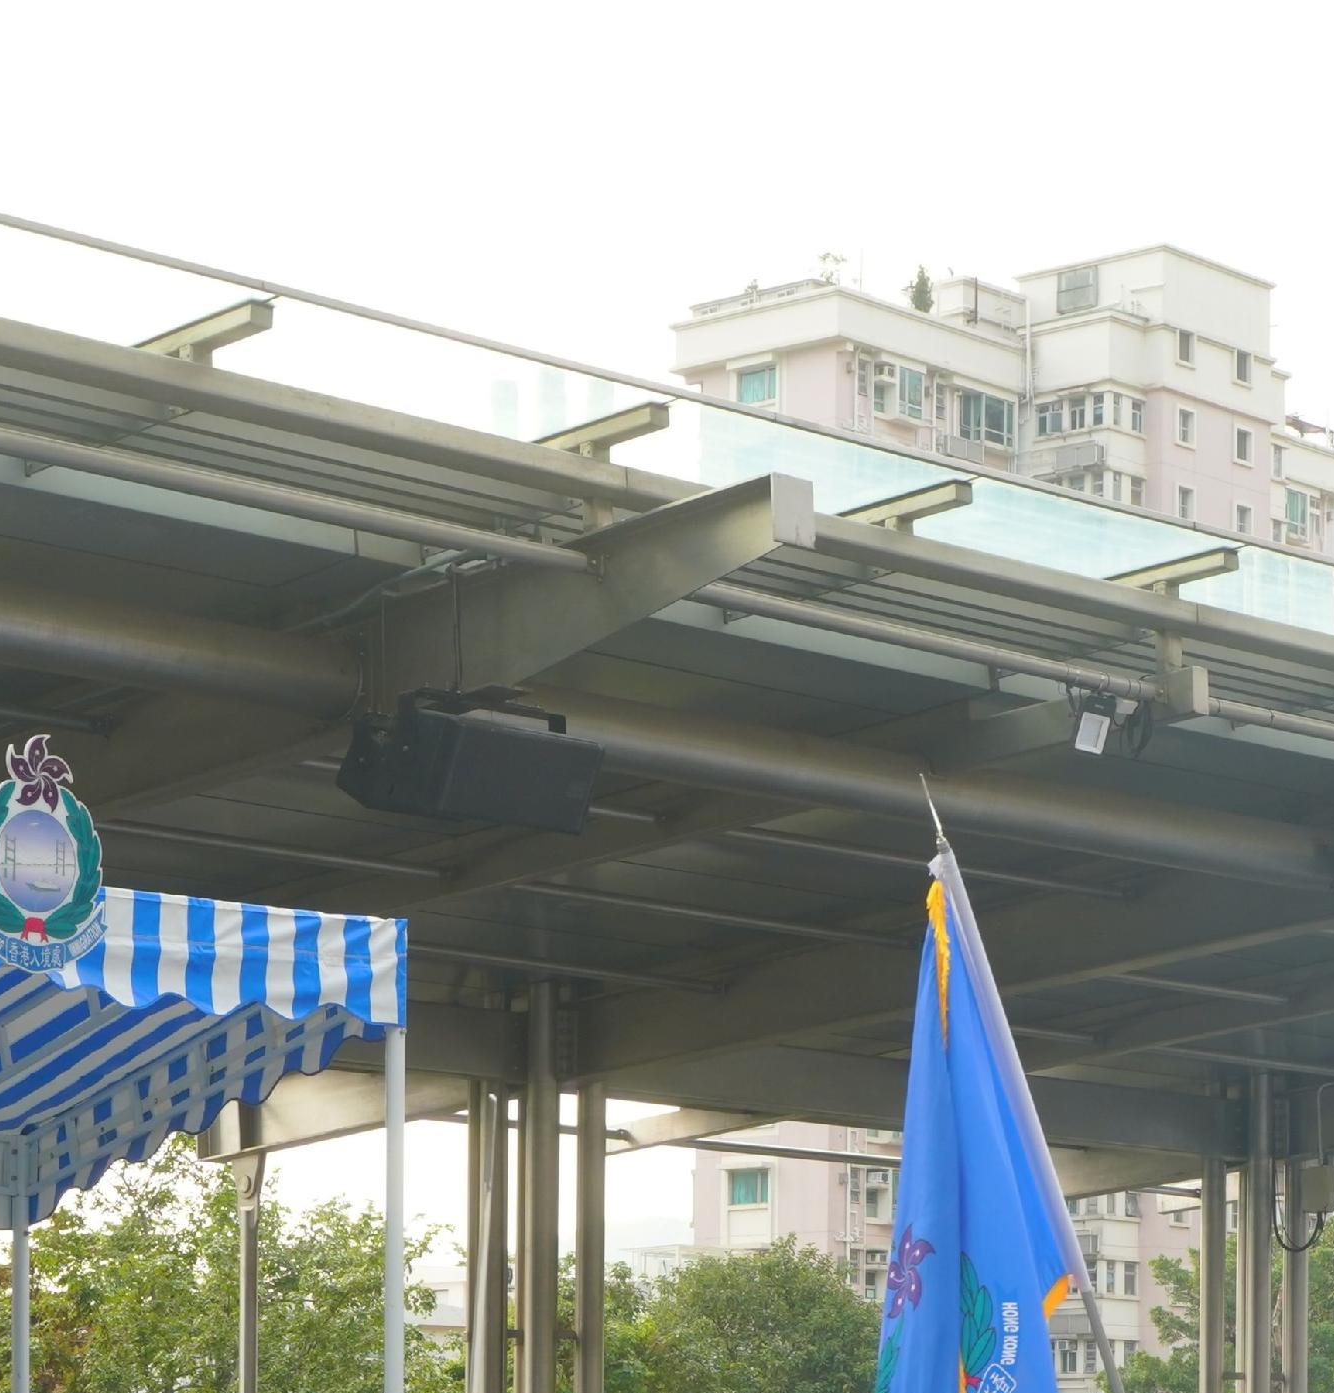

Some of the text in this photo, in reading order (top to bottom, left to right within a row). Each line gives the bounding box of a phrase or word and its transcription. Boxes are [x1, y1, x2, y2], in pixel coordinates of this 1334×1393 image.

[9, 941, 63, 968] 香港入境處
